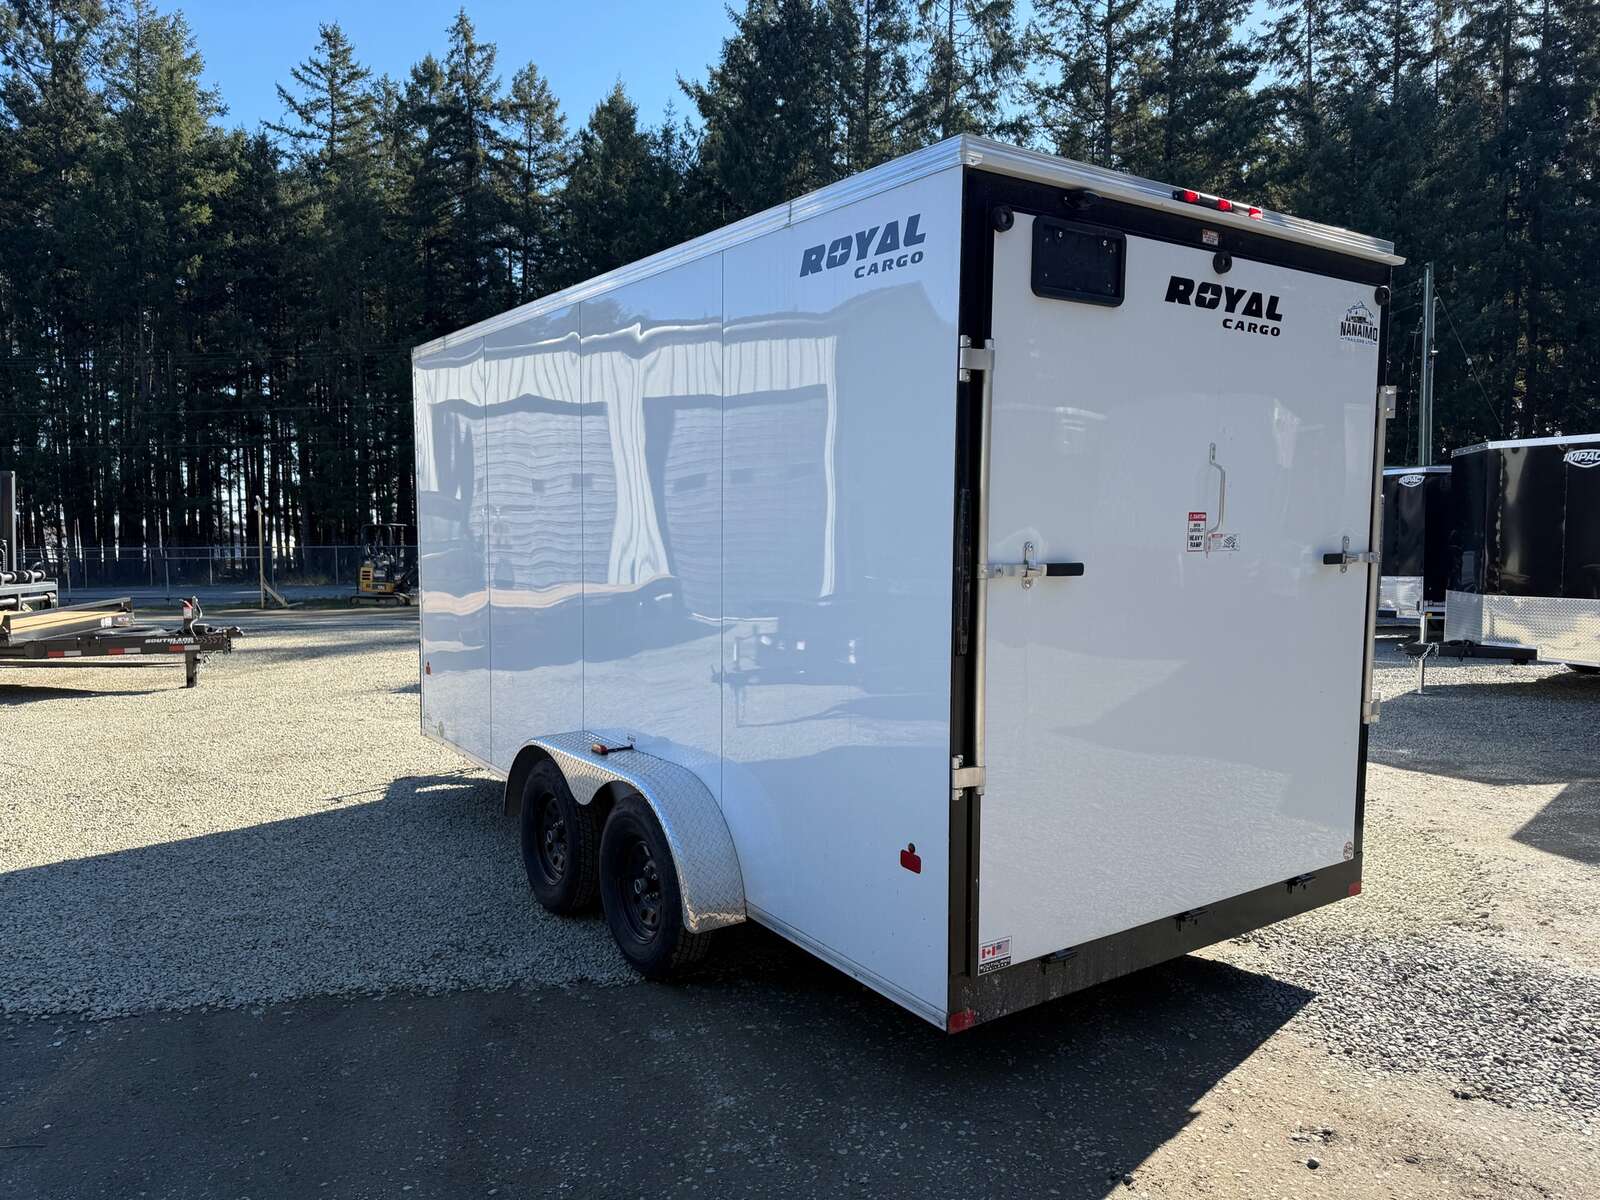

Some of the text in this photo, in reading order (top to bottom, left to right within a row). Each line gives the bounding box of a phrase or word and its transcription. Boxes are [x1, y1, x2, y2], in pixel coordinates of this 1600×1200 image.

[799, 213, 926, 278] ROYAL
[854, 250, 924, 279] CARGO
[1164, 275, 1283, 322] ROYAL
[1222, 318, 1281, 337] CARGO
[1340, 321, 1378, 342] NANAIMO
